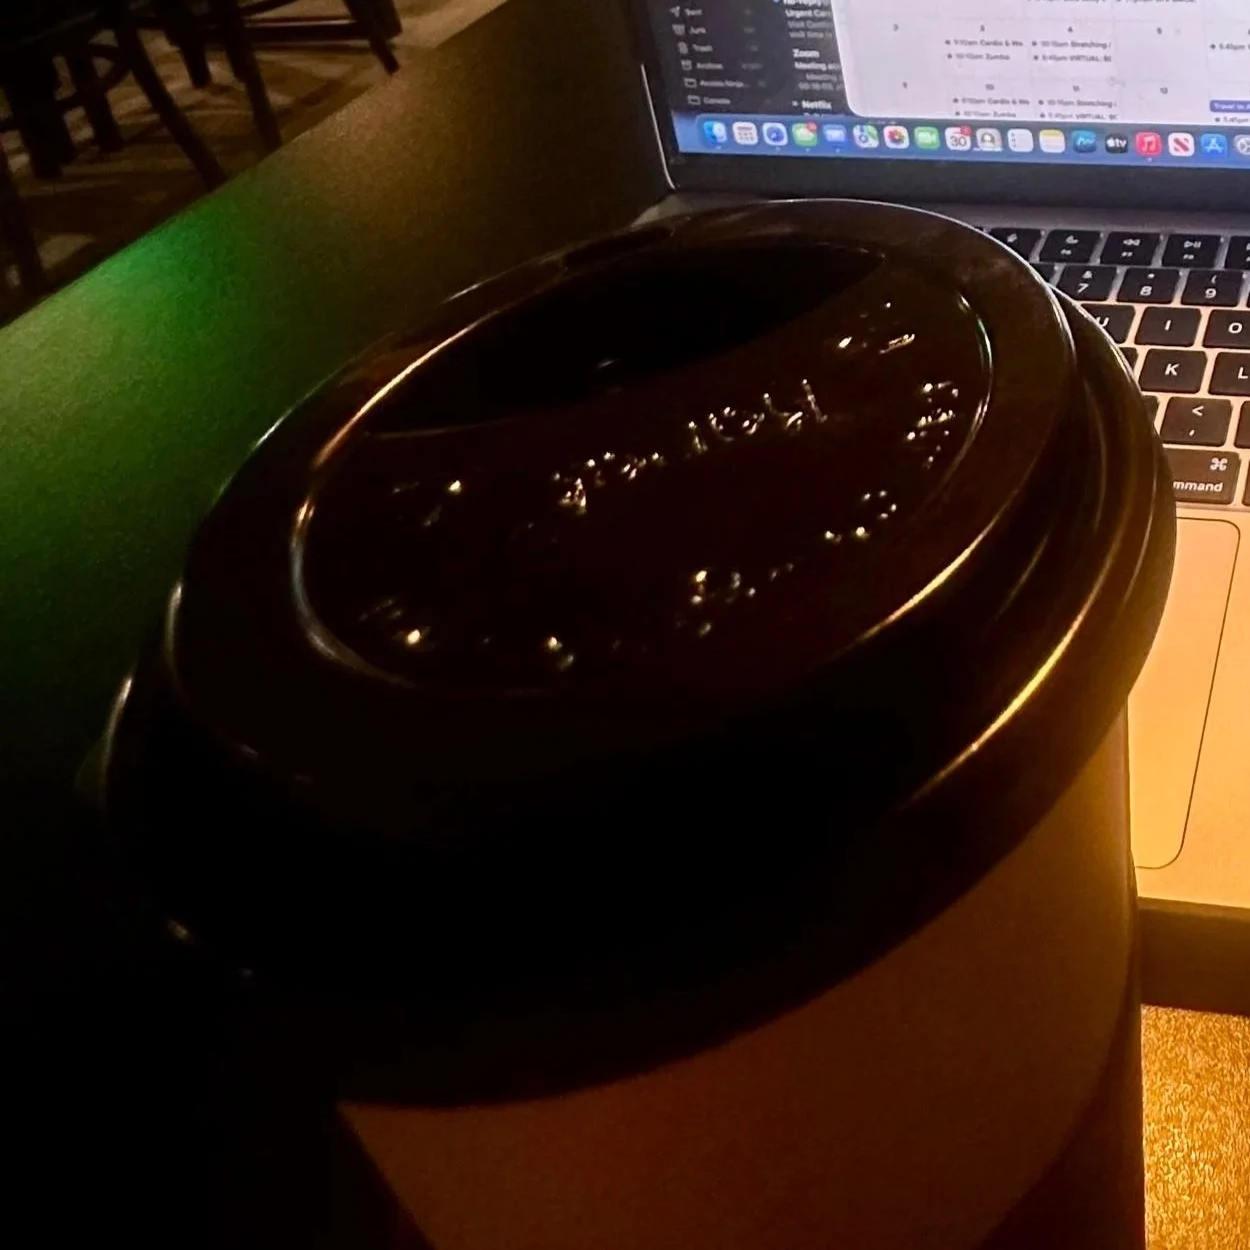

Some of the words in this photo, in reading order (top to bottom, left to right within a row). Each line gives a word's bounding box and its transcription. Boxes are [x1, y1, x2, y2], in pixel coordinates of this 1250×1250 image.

[793, 49, 820, 58] Zoom
[802, 100, 832, 110] Netflix
[950, 135, 967, 147] 30
[1077, 283, 1089, 293] 7
[1140, 286, 1152, 296] 8
[1205, 288, 1217, 298] 9
[1165, 363, 1180, 376] K
[1237, 367, 1249, 379] L
[1173, 480, 1223, 492] mmand
